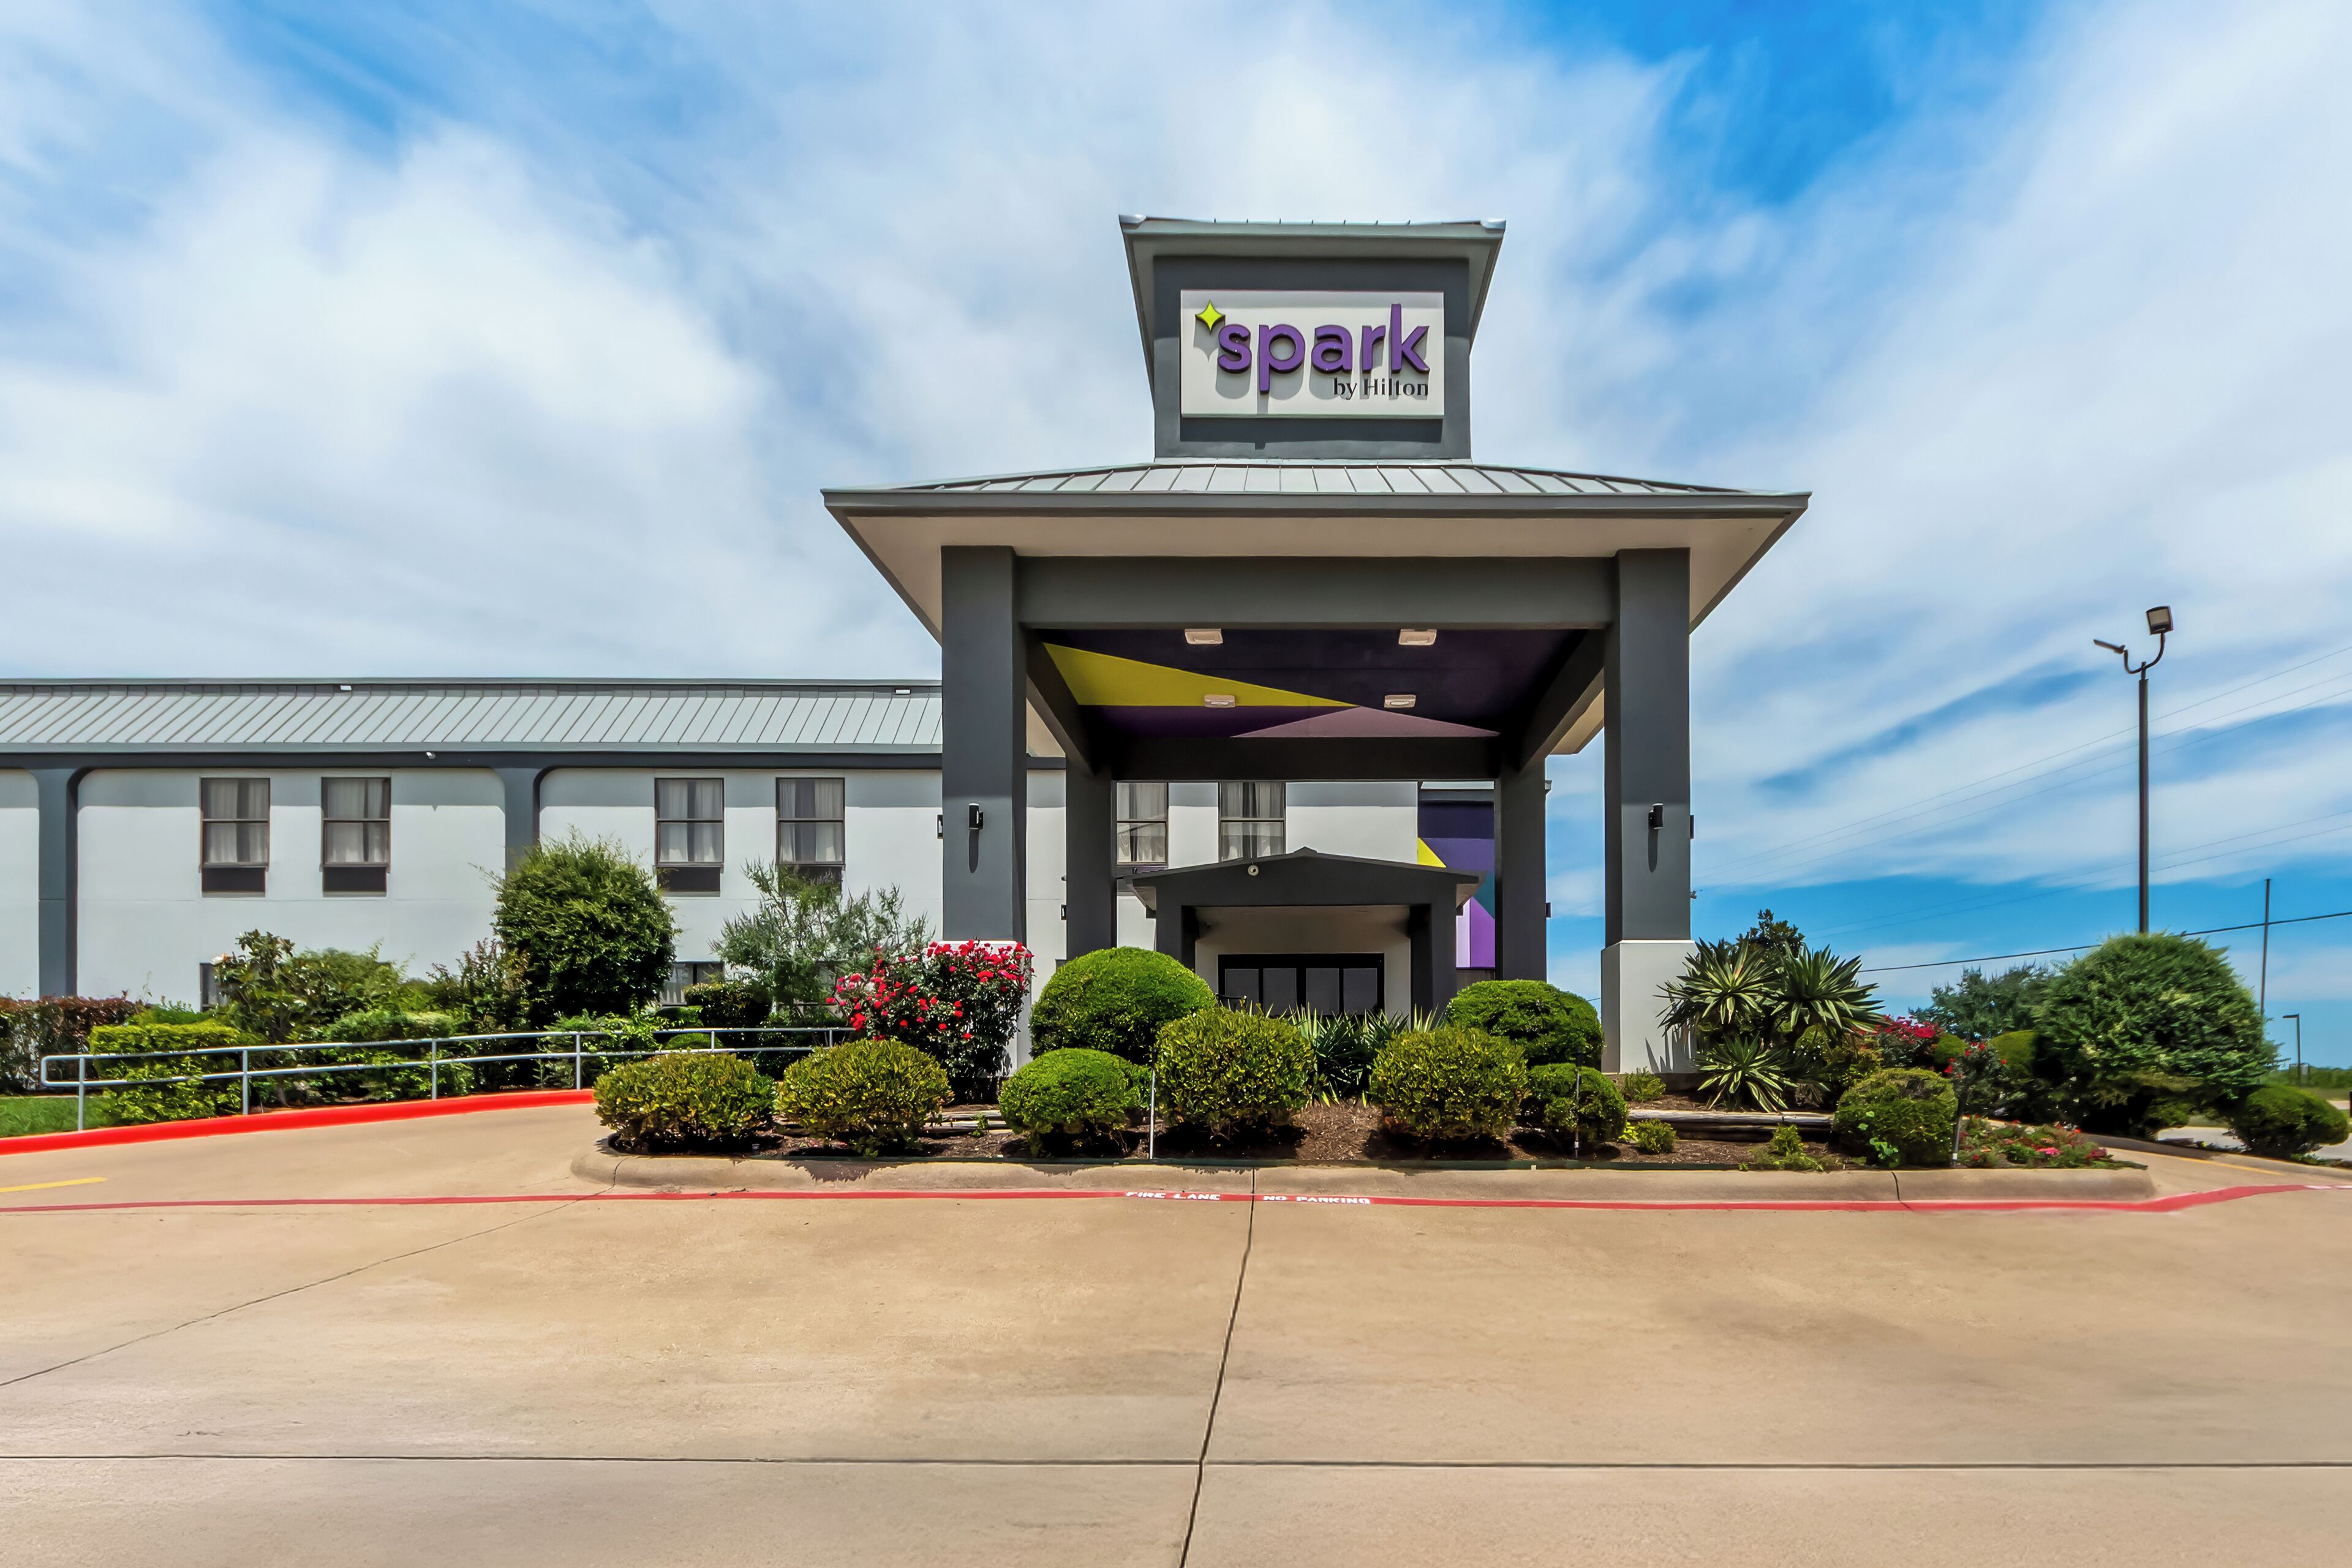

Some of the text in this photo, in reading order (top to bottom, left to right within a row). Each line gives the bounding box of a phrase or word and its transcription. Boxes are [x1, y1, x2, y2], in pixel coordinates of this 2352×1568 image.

[1218, 303, 1430, 394] spark
[1333, 377, 1428, 401] by Hilton
